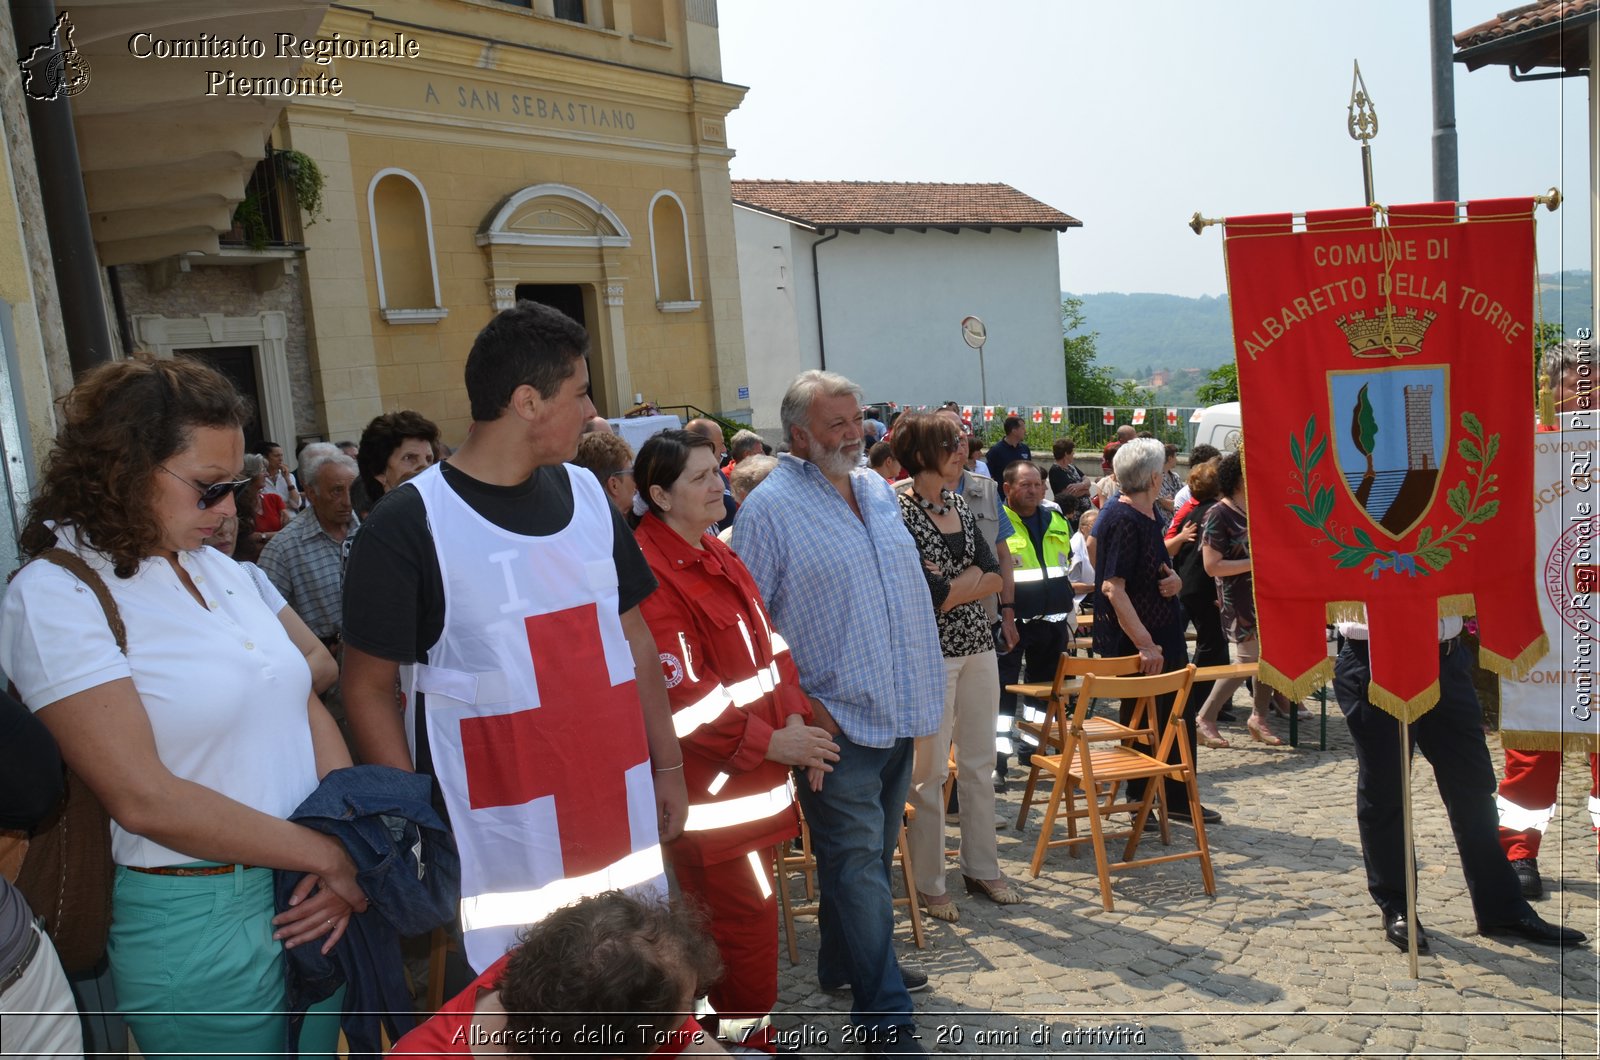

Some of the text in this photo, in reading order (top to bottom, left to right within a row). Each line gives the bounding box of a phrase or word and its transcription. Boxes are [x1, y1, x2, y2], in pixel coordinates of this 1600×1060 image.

[425, 82, 635, 131] A SAN SEBASTIANO
[1313, 238, 1449, 267] COMUNE DI
[1242, 272, 1525, 360] ALBARETTO DELLA TORRE
